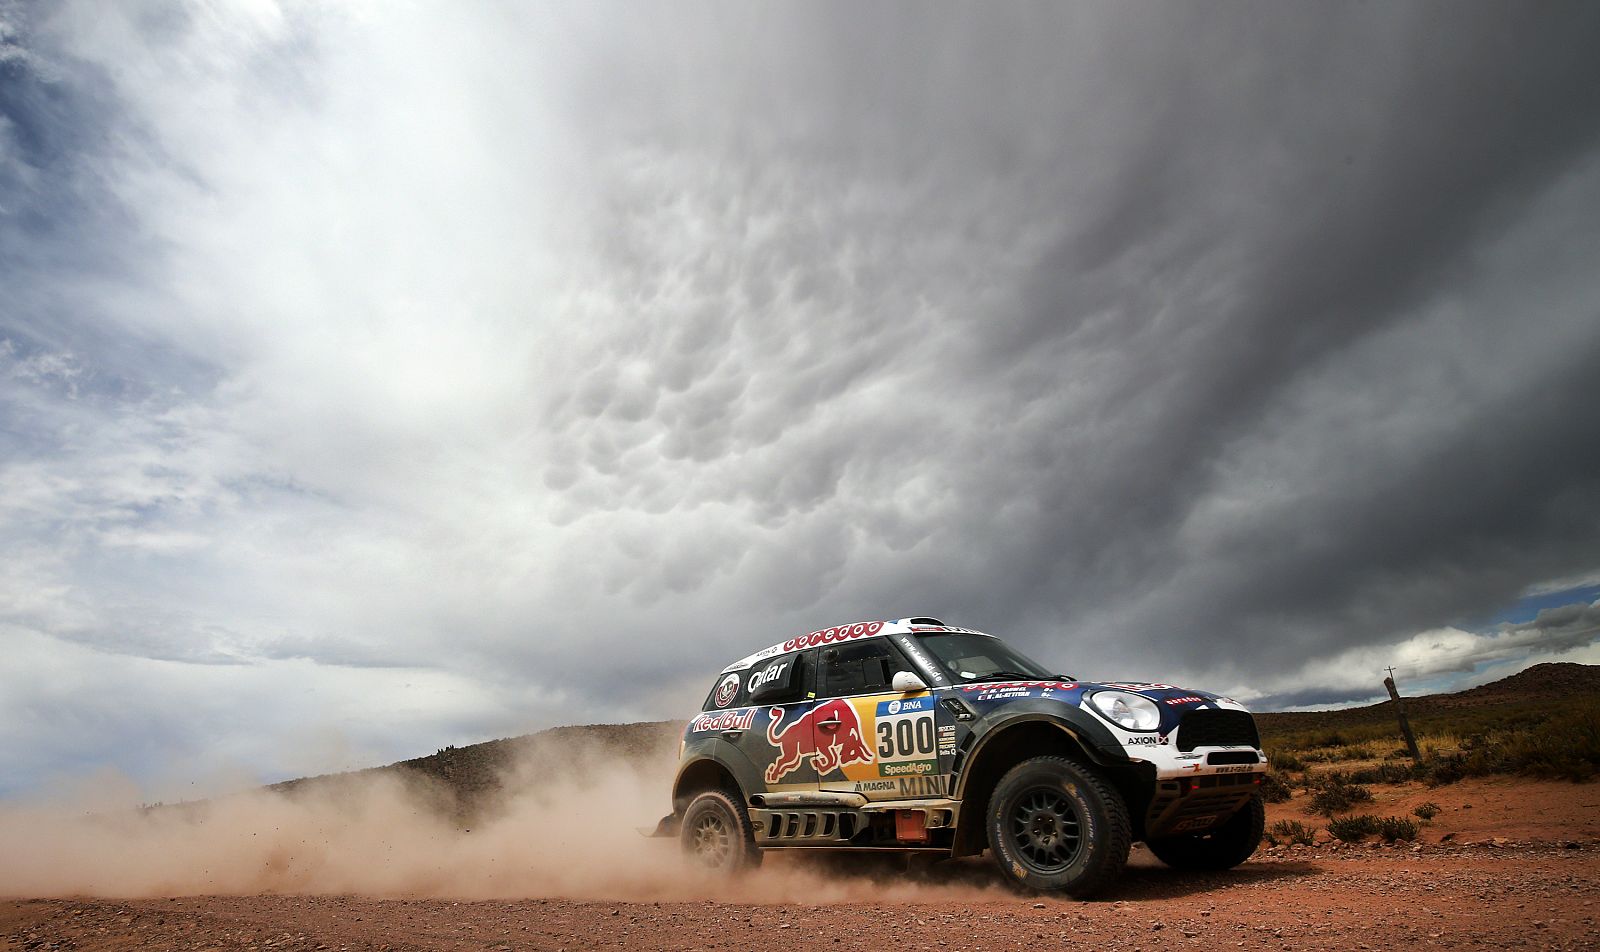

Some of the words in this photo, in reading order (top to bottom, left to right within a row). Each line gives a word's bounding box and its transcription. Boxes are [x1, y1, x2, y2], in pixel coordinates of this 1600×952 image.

[783, 621, 884, 651] ooredoo
[748, 662, 788, 693] Qatar
[902, 700, 922, 711] BNA
[693, 712, 723, 733] Red
[720, 707, 759, 730] Bull
[877, 716, 935, 758] 300
[1127, 737, 1157, 745] AXION
[884, 762, 932, 776] SpeedAgro
[863, 781, 896, 792] MAGNA
[899, 775, 948, 797] MINI
